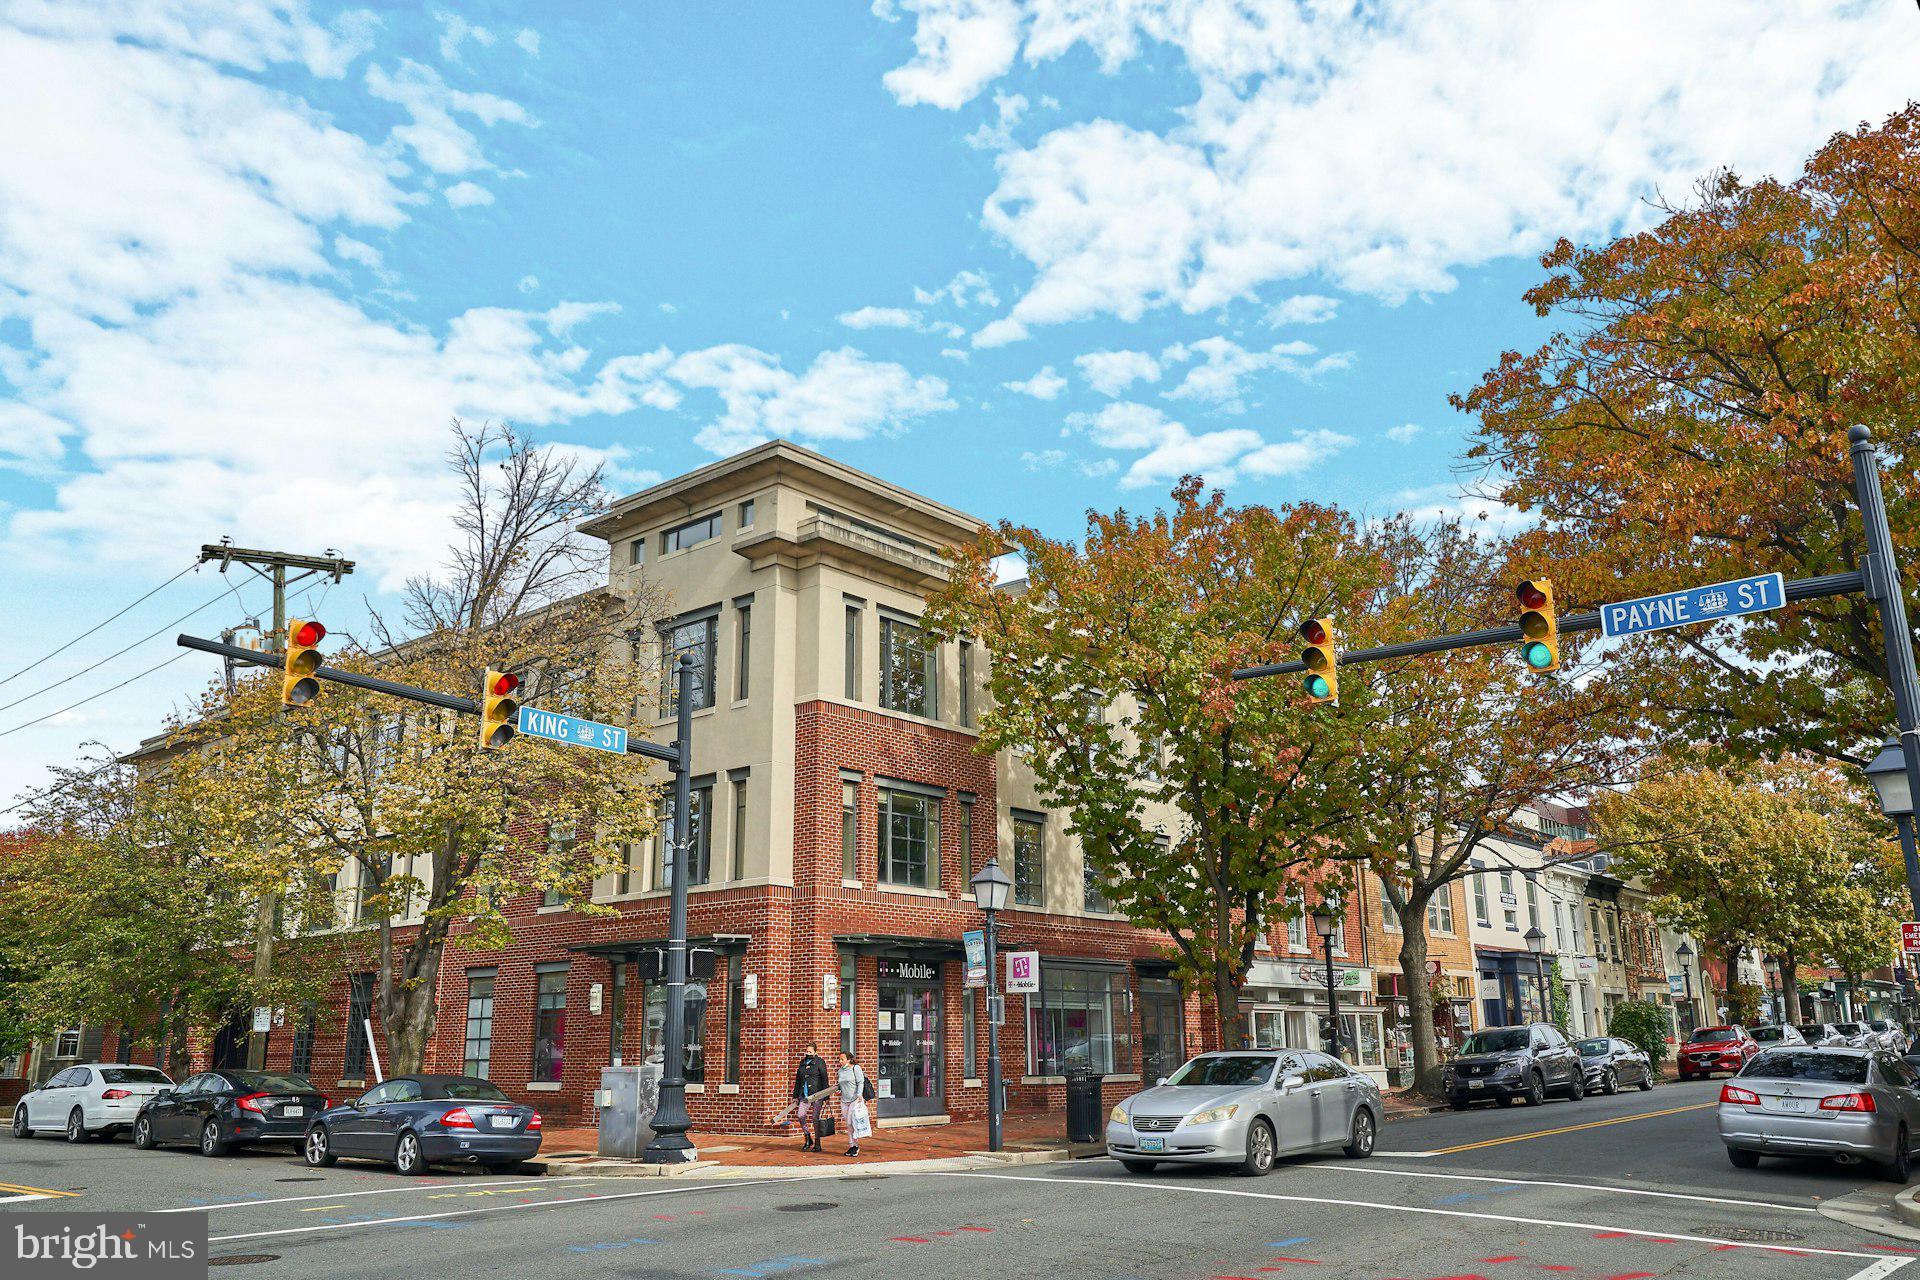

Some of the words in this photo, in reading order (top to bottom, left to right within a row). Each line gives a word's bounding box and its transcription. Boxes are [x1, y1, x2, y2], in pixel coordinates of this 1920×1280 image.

[1613, 596, 1690, 632] PAYNE
[1738, 579, 1769, 609] ST
[527, 711, 569, 739] KING
[602, 728, 621, 749] ST
